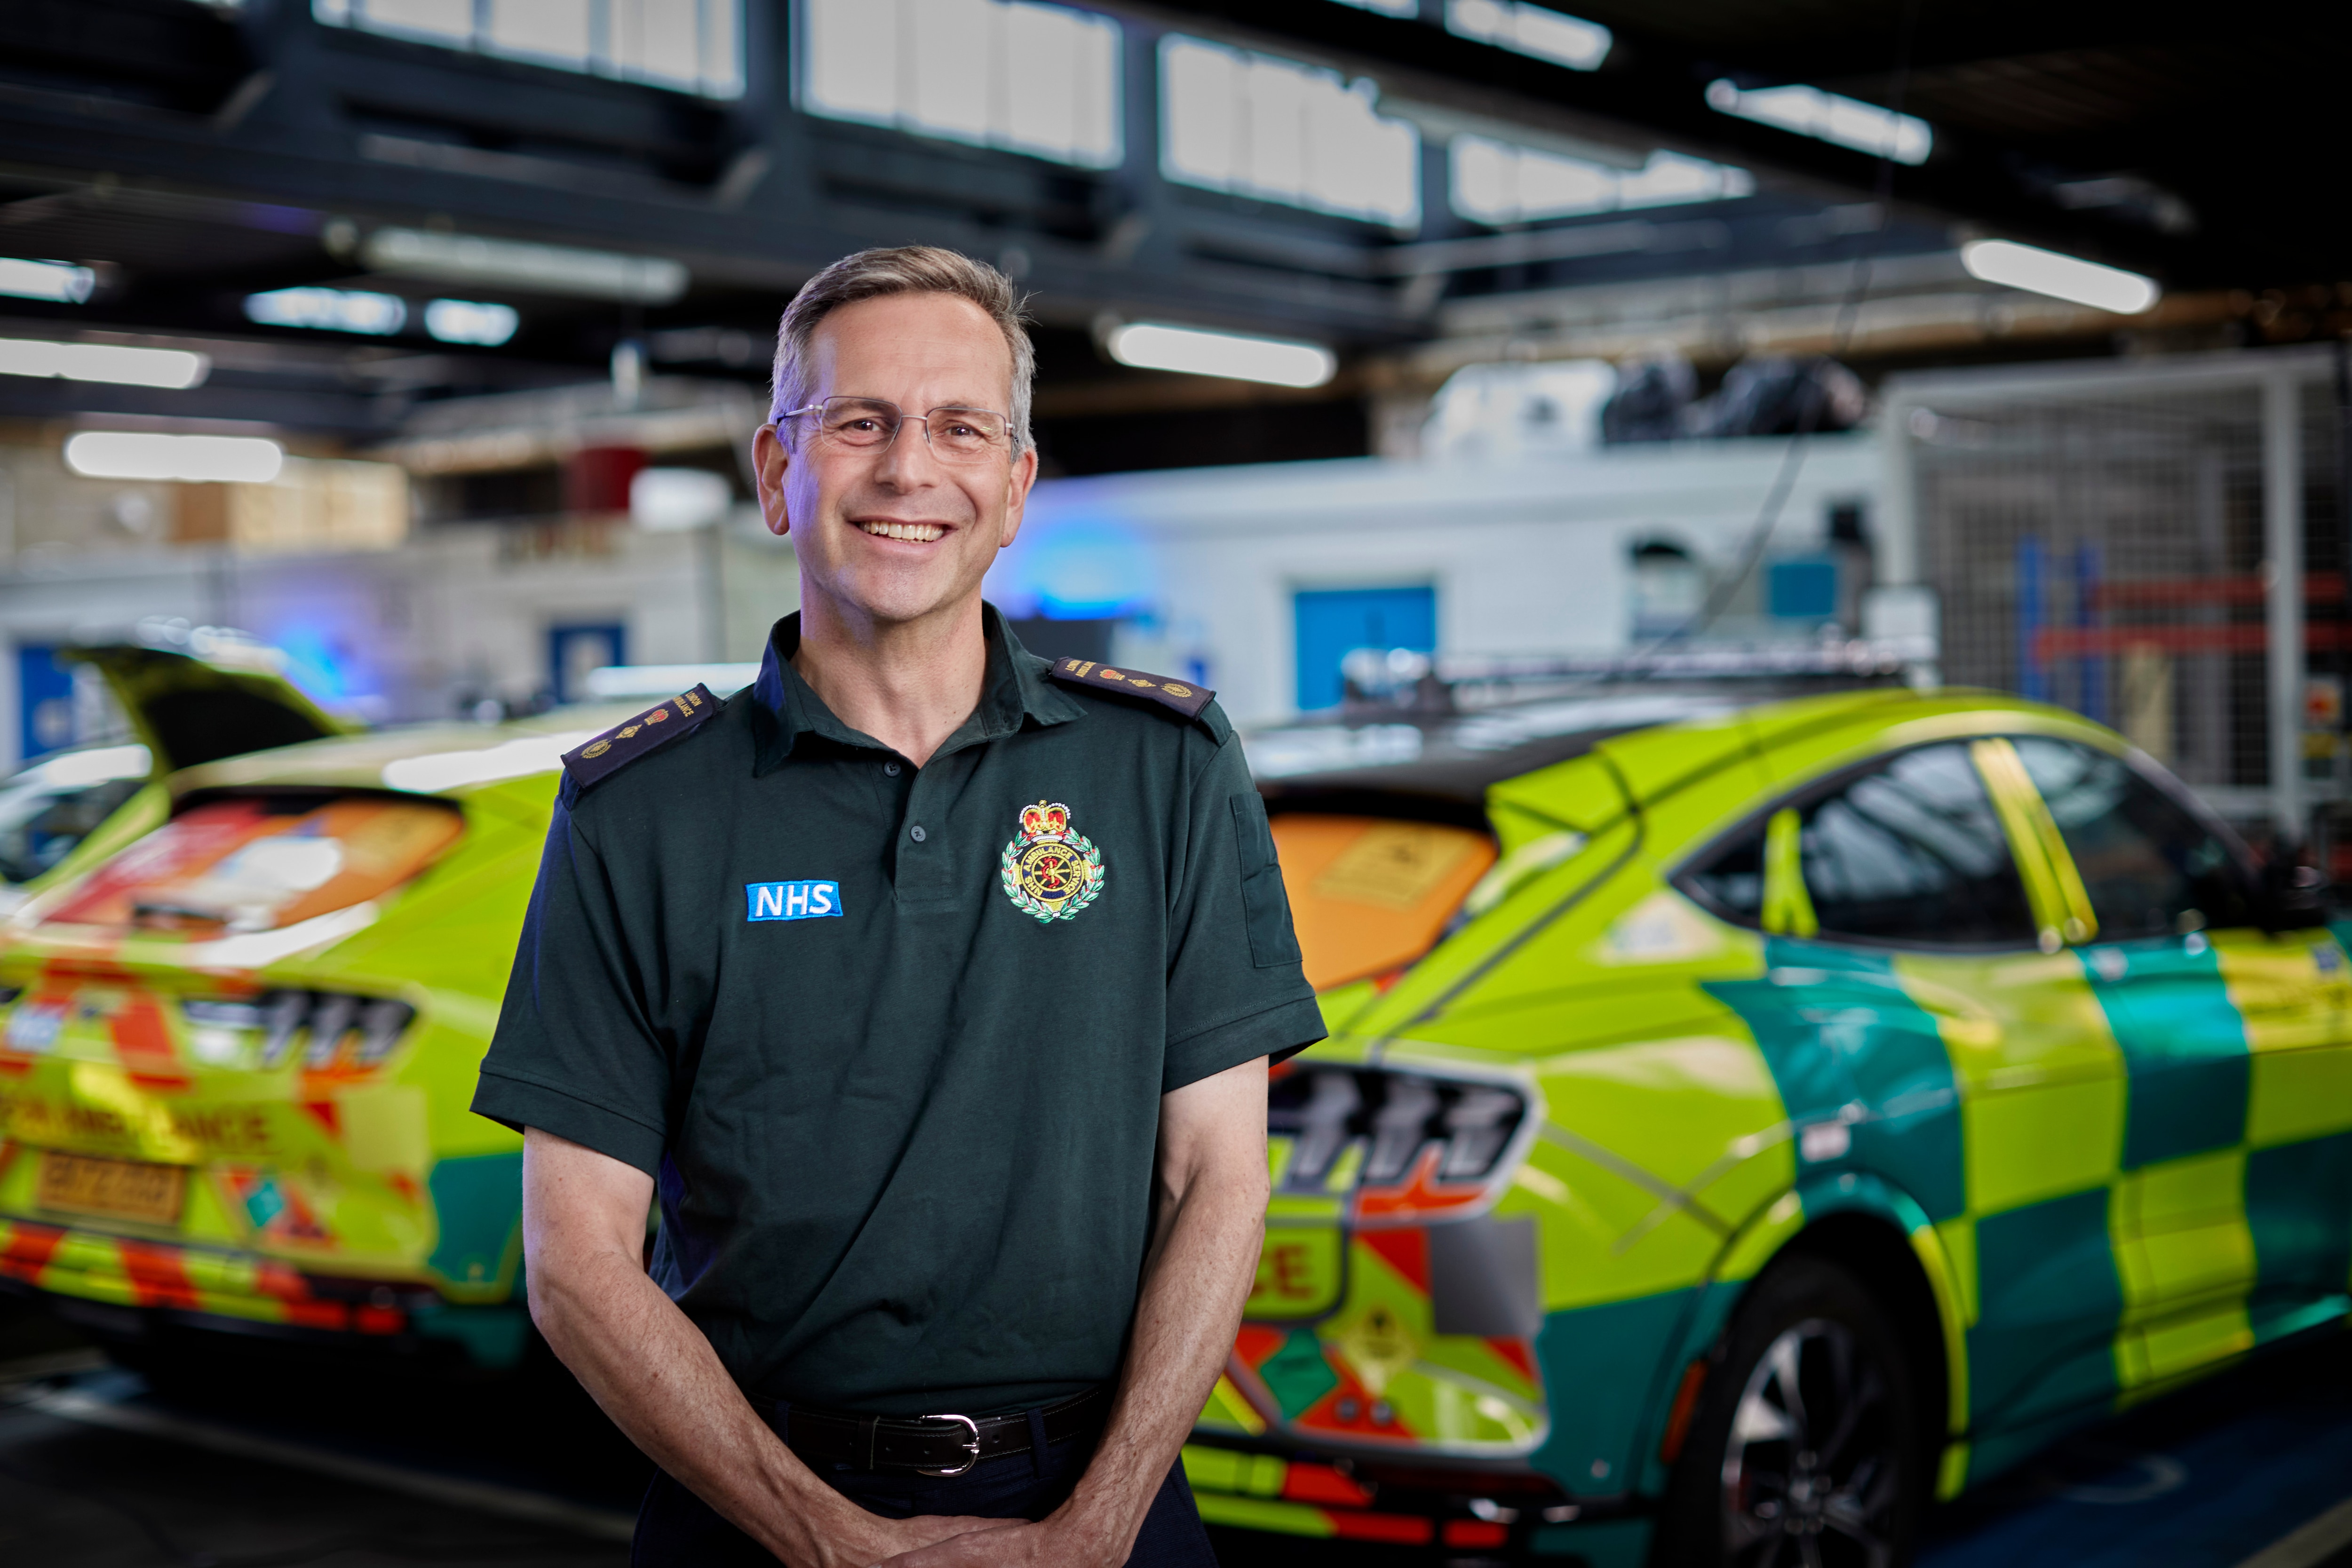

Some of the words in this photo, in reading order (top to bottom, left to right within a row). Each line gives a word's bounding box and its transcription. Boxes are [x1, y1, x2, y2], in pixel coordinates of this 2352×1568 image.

[1065, 660, 1082, 671] LON
[685, 691, 703, 707] LONDON
[1024, 846, 1073, 872] AMBULANCE
[1025, 876, 1043, 896] NHS
[1065, 860, 1081, 894] SERVICE
[755, 884, 834, 916] NHS
